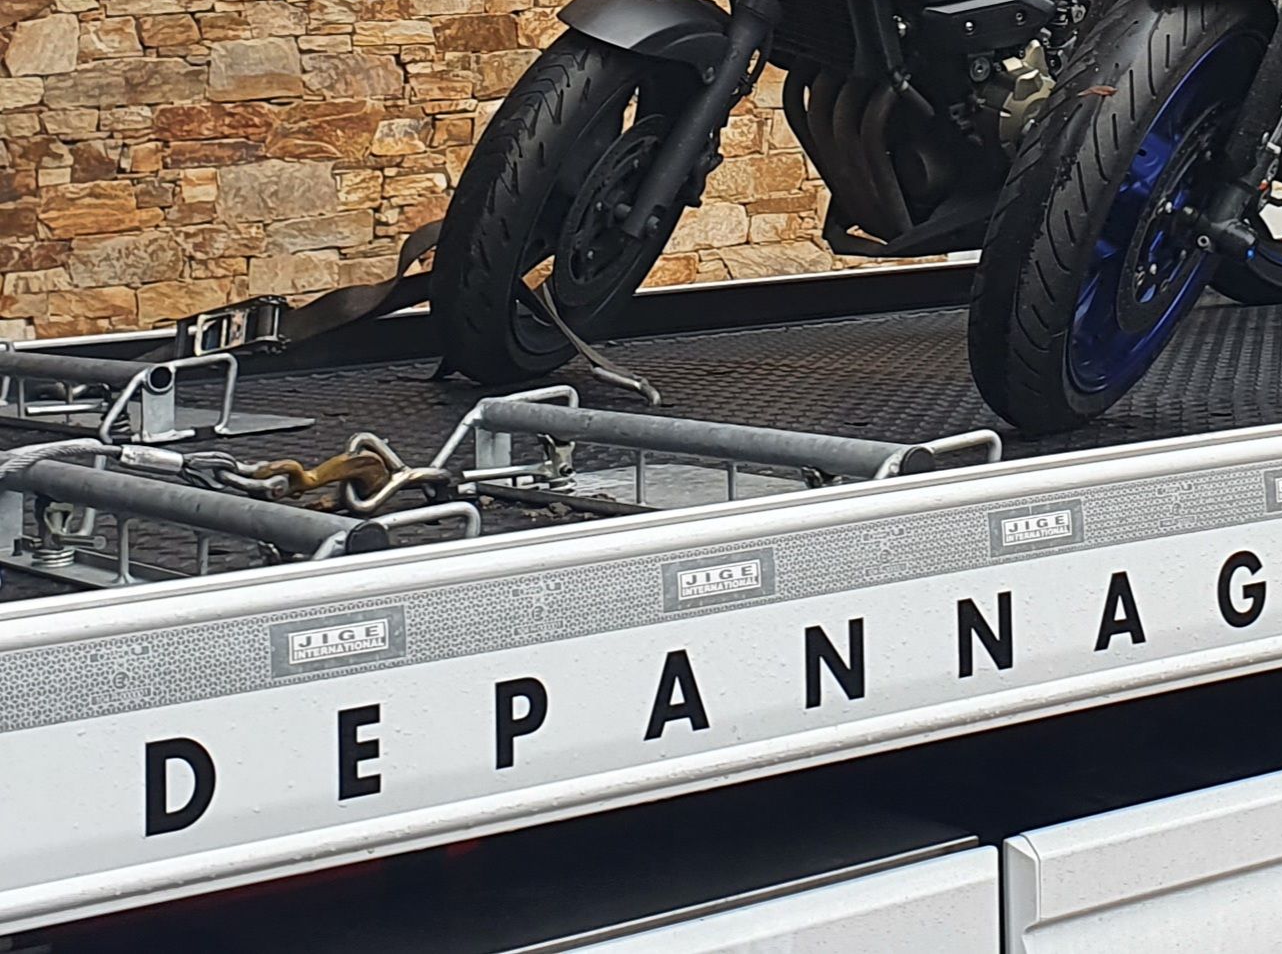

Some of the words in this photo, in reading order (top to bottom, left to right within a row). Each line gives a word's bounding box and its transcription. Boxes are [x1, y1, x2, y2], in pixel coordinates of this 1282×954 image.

[1008, 515, 1066, 533] JIGE
[685, 565, 754, 586] JIGE
[682, 576, 759, 597] INTERNATIONAL
[298, 625, 380, 648] JIGE
[293, 637, 386, 660] INTERNATIONAL
